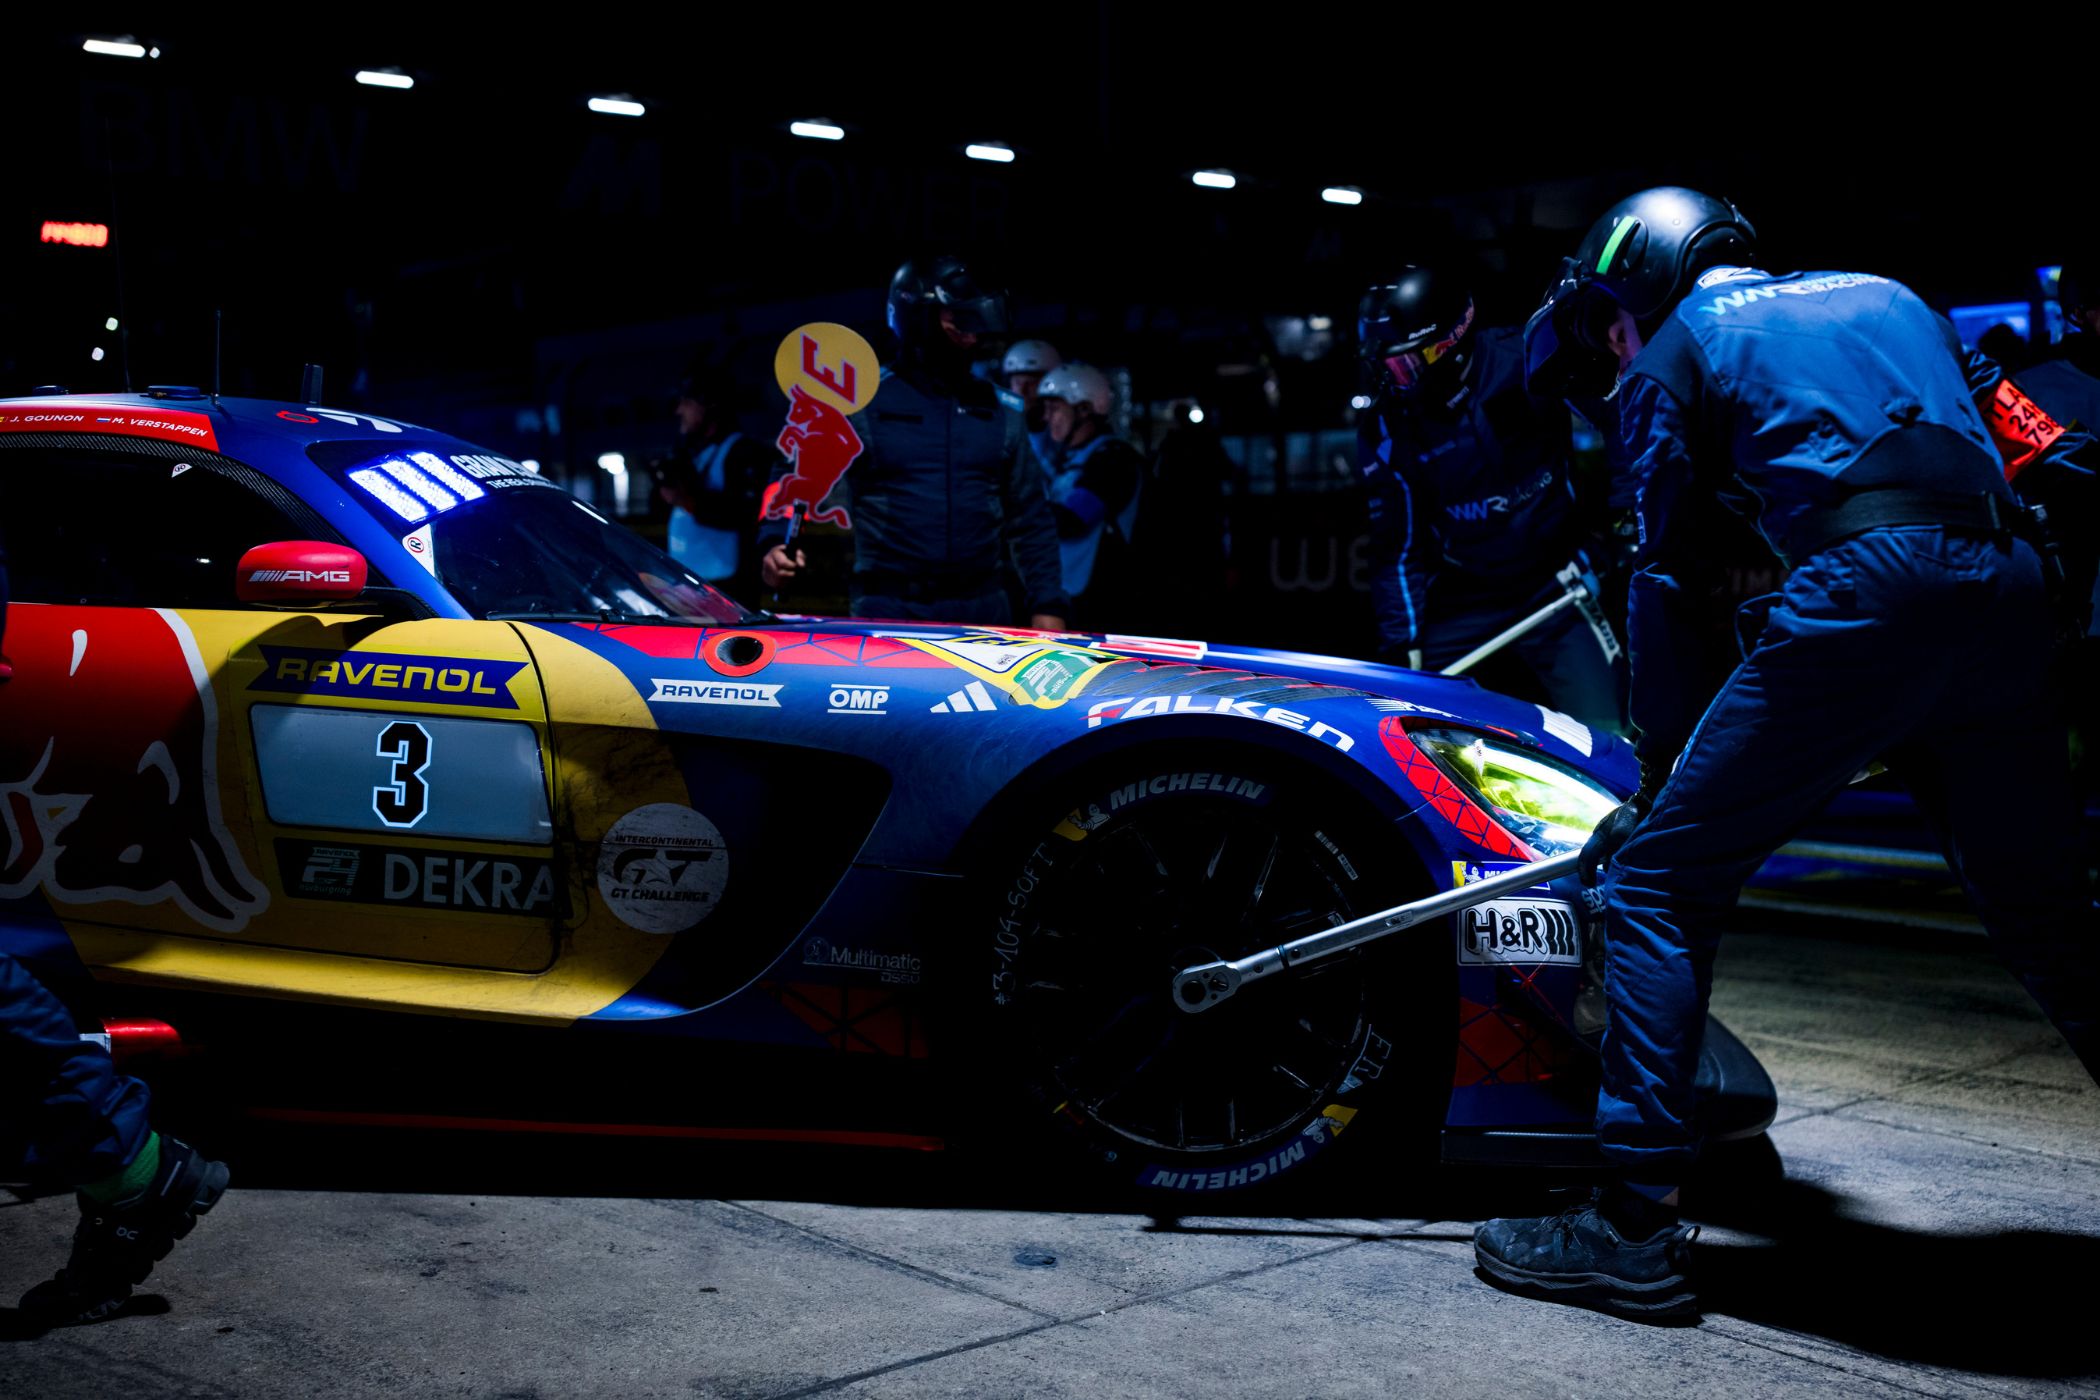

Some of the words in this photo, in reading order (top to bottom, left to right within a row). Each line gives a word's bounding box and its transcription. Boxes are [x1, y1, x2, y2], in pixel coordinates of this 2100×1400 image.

[80, 80, 369, 192] BMW
[728, 146, 1009, 240] POWER
[801, 333, 855, 404] E
[24, 415, 84, 423] GOUNON
[111, 416, 125, 425] M.
[130, 418, 209, 438] VERSTAPPEN
[284, 570, 350, 583] AMG
[275, 657, 498, 696] RAVENOL
[661, 683, 771, 702] RAVENOL
[828, 689, 890, 710] OMP
[1086, 695, 1356, 753] FALKEN
[372, 720, 433, 829] 3
[1109, 771, 1267, 811] MICHELIN
[616, 833, 714, 847] INTERCONTINENTAL
[383, 851, 556, 912] DEKRA
[611, 887, 629, 899] GT
[631, 889, 710, 902] CHALLENGE
[1466, 909, 1544, 951] H&R
[831, 945, 921, 971] Multimatic
[1151, 1140, 1306, 1190] MICHELIN
